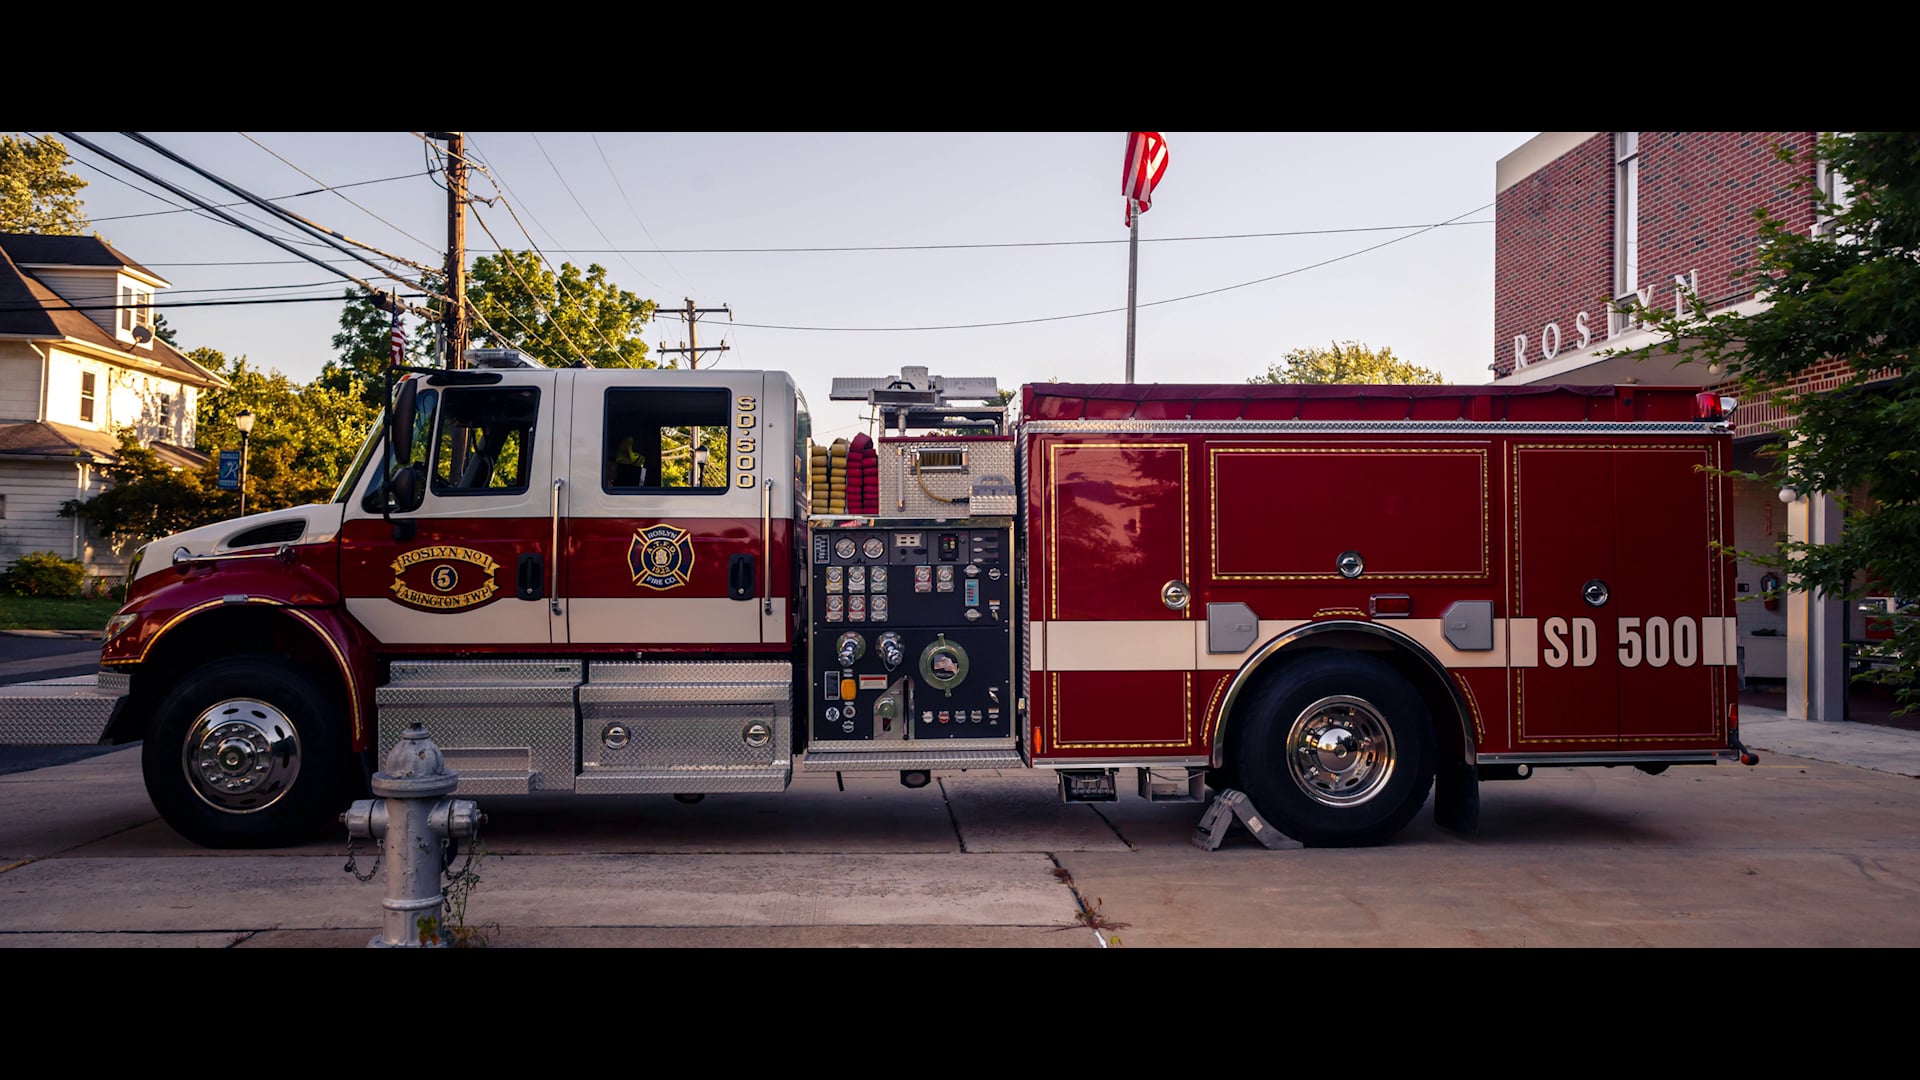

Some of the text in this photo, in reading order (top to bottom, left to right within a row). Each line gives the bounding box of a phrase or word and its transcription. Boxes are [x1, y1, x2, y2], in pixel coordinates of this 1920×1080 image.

[1514, 269, 1699, 371] ROSLYN
[648, 530, 677, 539] ROSLYN
[401, 547, 459, 565] ROSLYN
[437, 568, 451, 588] 5
[646, 576, 663, 585] FIRE
[400, 589, 460, 607] ABINGTON
[1543, 616, 1698, 668] SD 500
